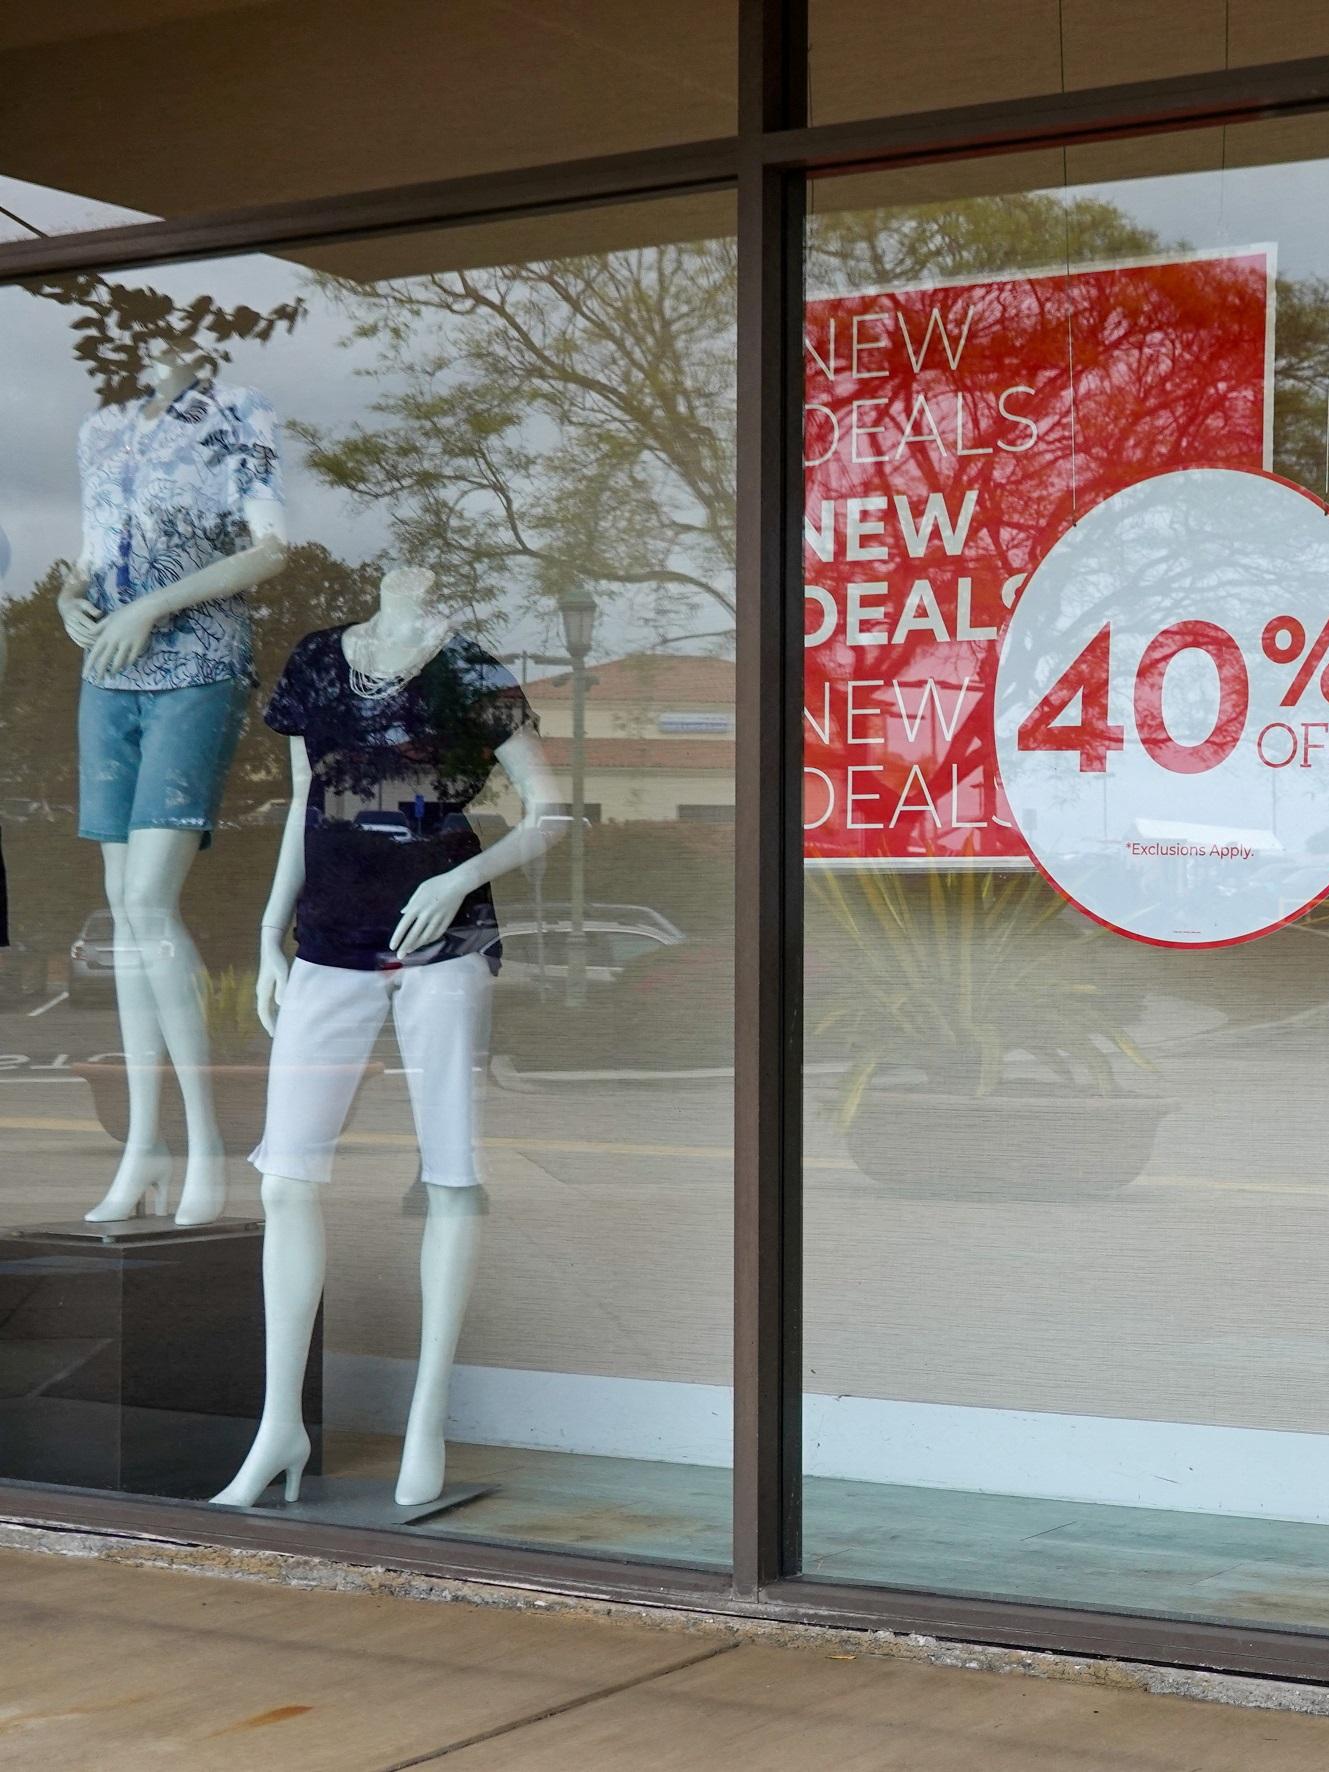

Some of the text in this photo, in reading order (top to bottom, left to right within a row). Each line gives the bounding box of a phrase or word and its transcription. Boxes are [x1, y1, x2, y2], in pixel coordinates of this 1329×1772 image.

[805, 305, 975, 381] NEW
[805, 386, 1038, 467] DEALS
[805, 490, 979, 563] NEW
[804, 763, 1013, 830] DEAL
[1209, 843, 1255, 859] Apply.
